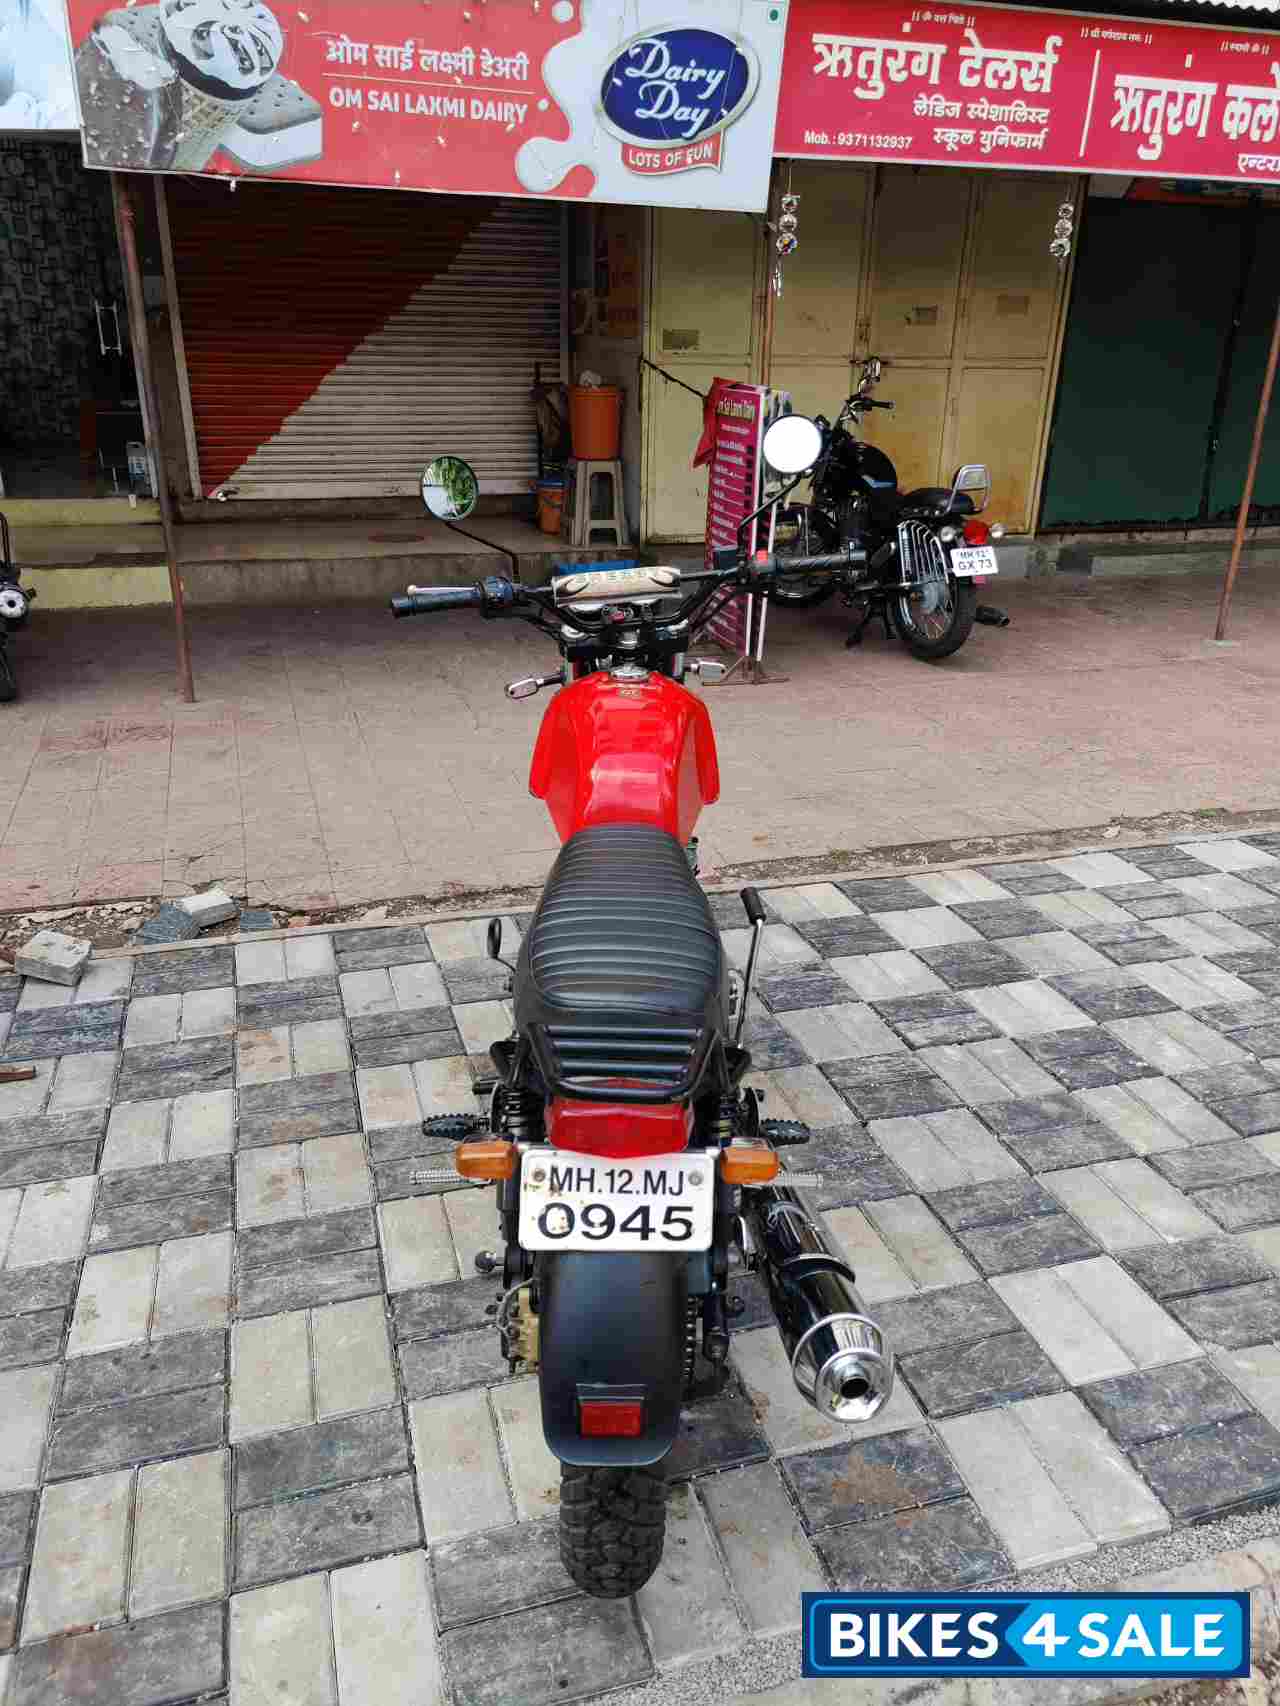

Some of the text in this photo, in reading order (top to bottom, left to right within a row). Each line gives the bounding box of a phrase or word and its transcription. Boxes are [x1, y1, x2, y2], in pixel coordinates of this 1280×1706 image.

[326, 33, 529, 81] ओम साई लक्ष्मी डेअरी
[625, 38, 727, 100] Dairy
[812, 21, 1063, 100] ऋतुरंग टेलर्स
[329, 87, 528, 124] OM SAI LAXMI DAIRY
[635, 80, 711, 137] Day
[912, 92, 963, 119] लेडिज
[1110, 53, 1218, 160] ऋतुरंग
[628, 143, 713, 168] LOTS OF FUN
[932, 126, 1049, 152] स्कूल युनिफार्म
[550, 1166, 684, 1196] MH.12.MJ
[537, 1202, 694, 1242] 0945
